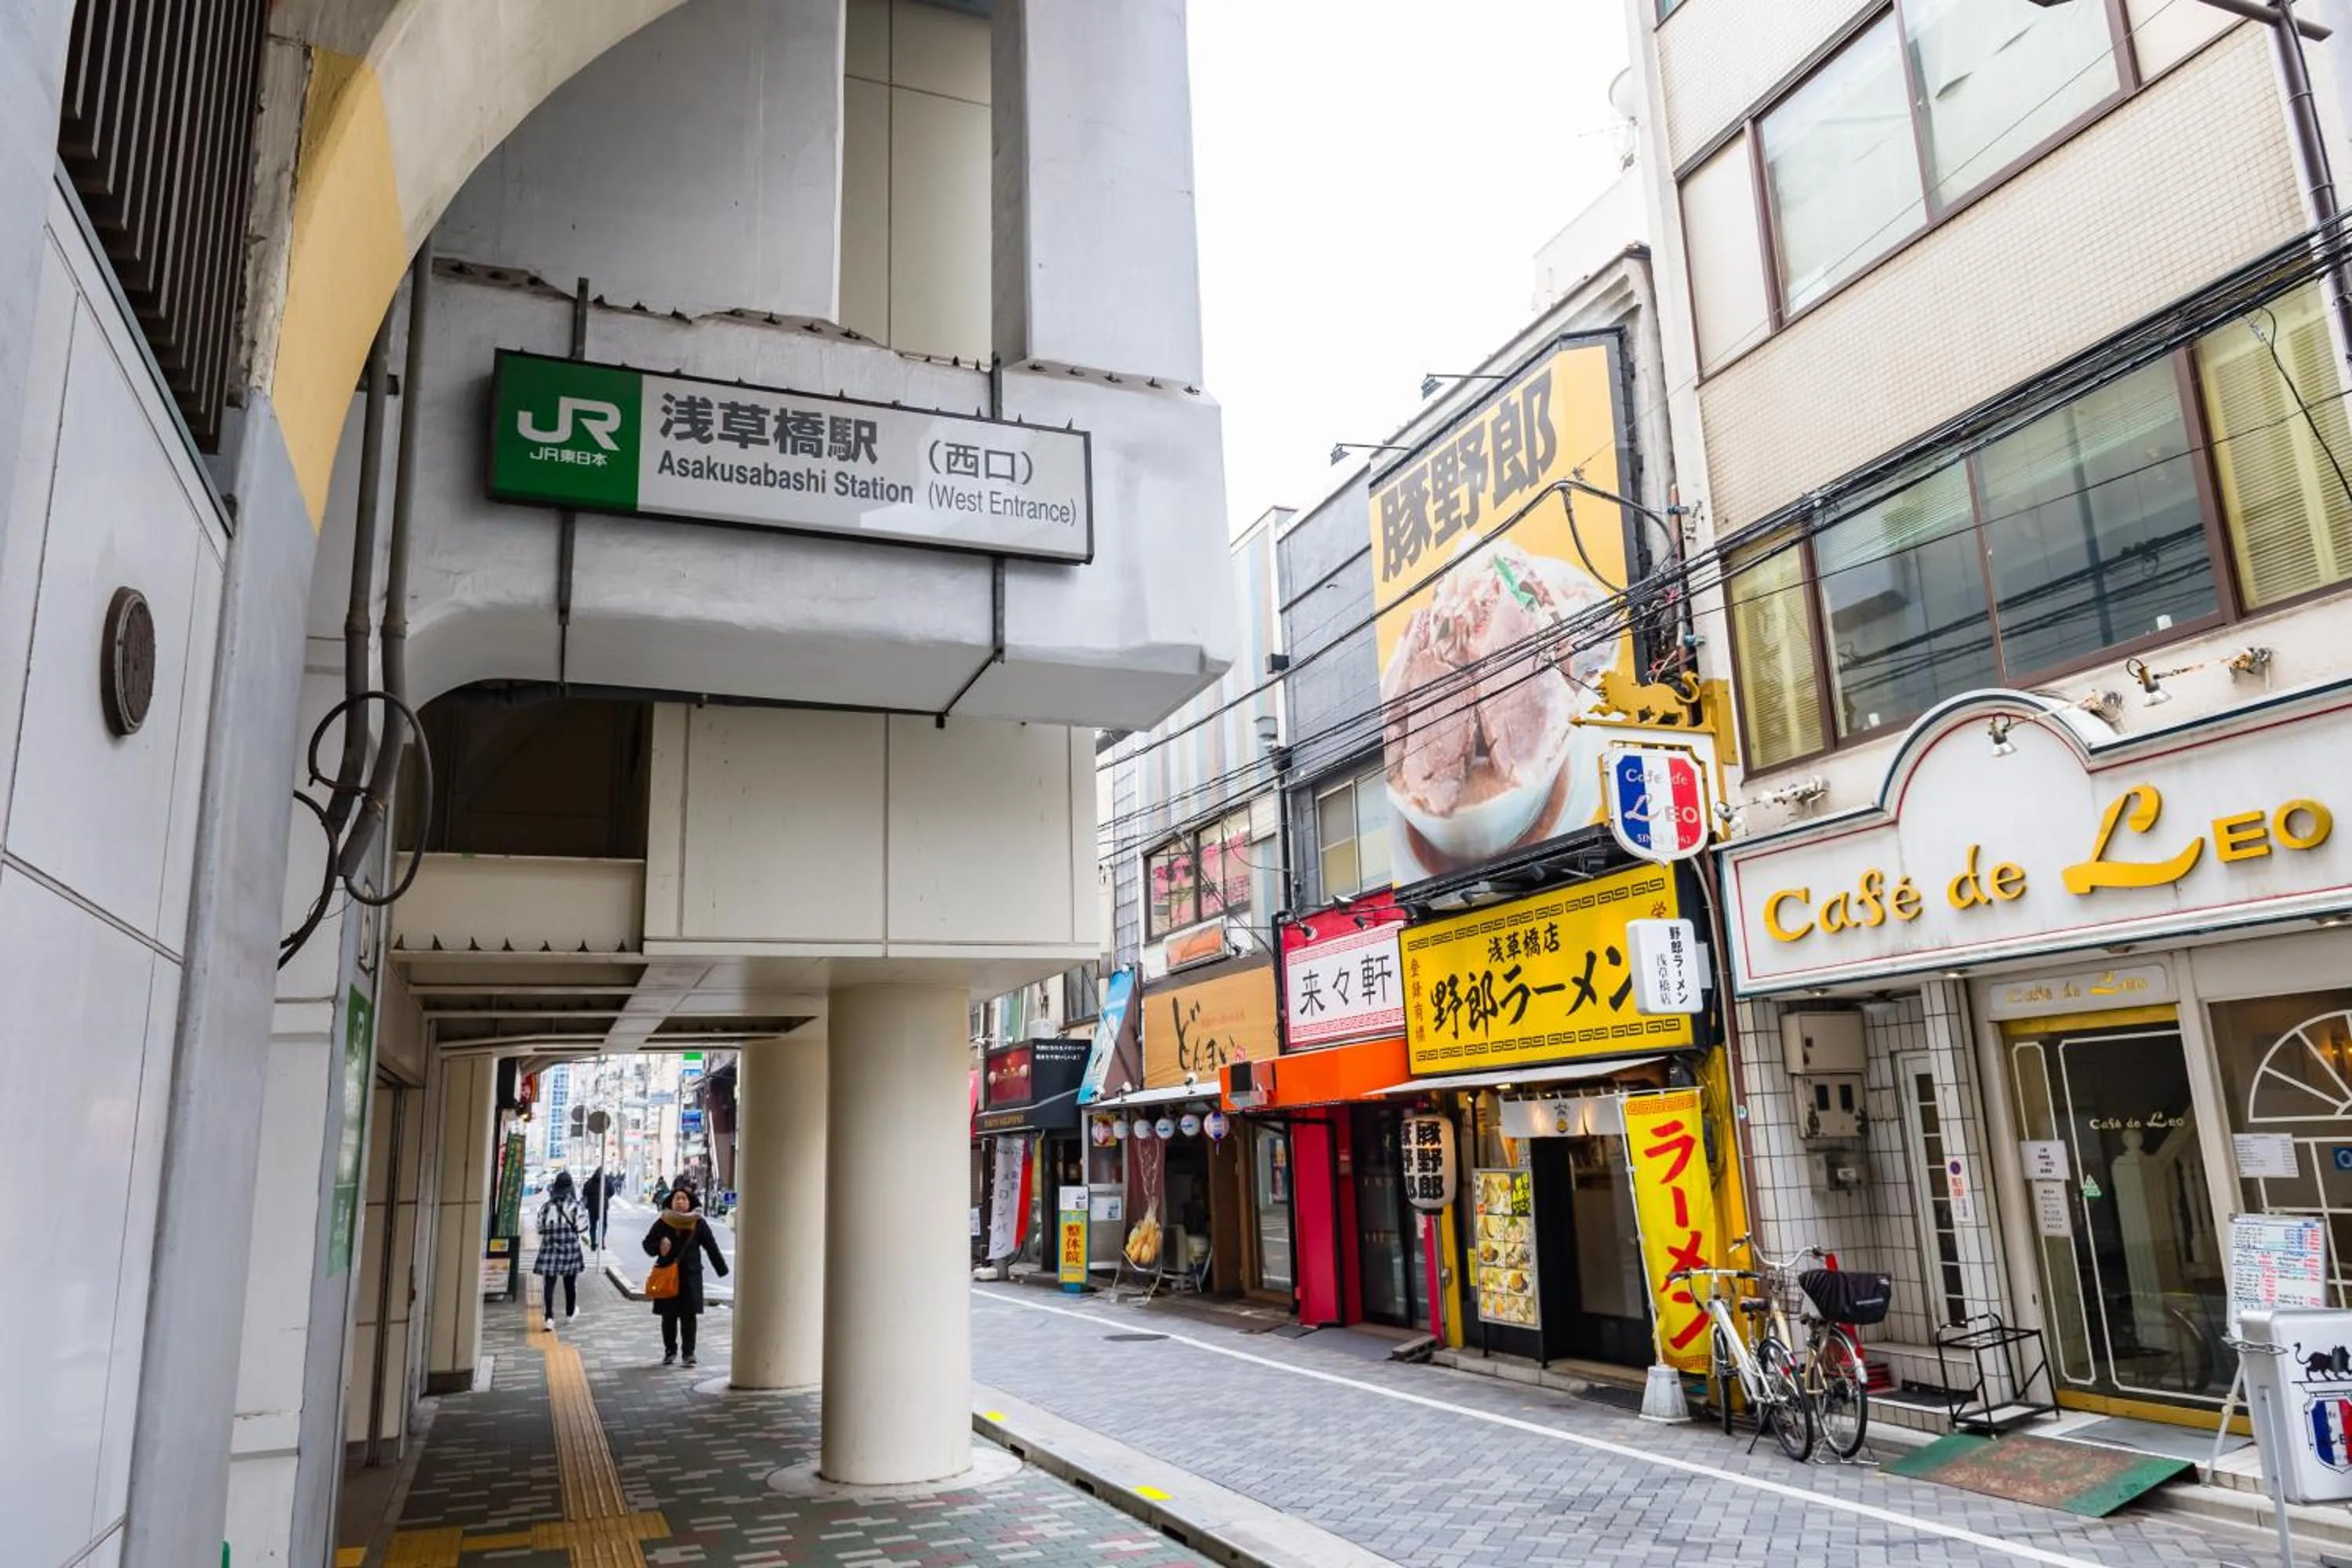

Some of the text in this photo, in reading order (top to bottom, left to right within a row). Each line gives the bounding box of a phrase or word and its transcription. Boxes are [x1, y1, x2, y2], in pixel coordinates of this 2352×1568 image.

[517, 396, 622, 452] JR
[530, 446, 608, 468] JR東日本
[659, 392, 878, 465] 浅草橋駅
[657, 449, 914, 504] Asakusabashi Station
[928, 481, 1076, 528] (West Entrance)
[1381, 368, 1557, 583] 豚野郎
[1763, 868, 1925, 942] Café
[1947, 843, 2026, 910] de
[1487, 920, 1561, 964] 浅草橋店
[1668, 926, 1689, 1005] 野郎ラーメン
[1298, 953, 1393, 1017] 来々軒
[1429, 945, 1632, 1040] 野郎ラーメン
[1171, 996, 1236, 1073] どんまい
[1643, 1119, 1711, 1351] ラーメン
